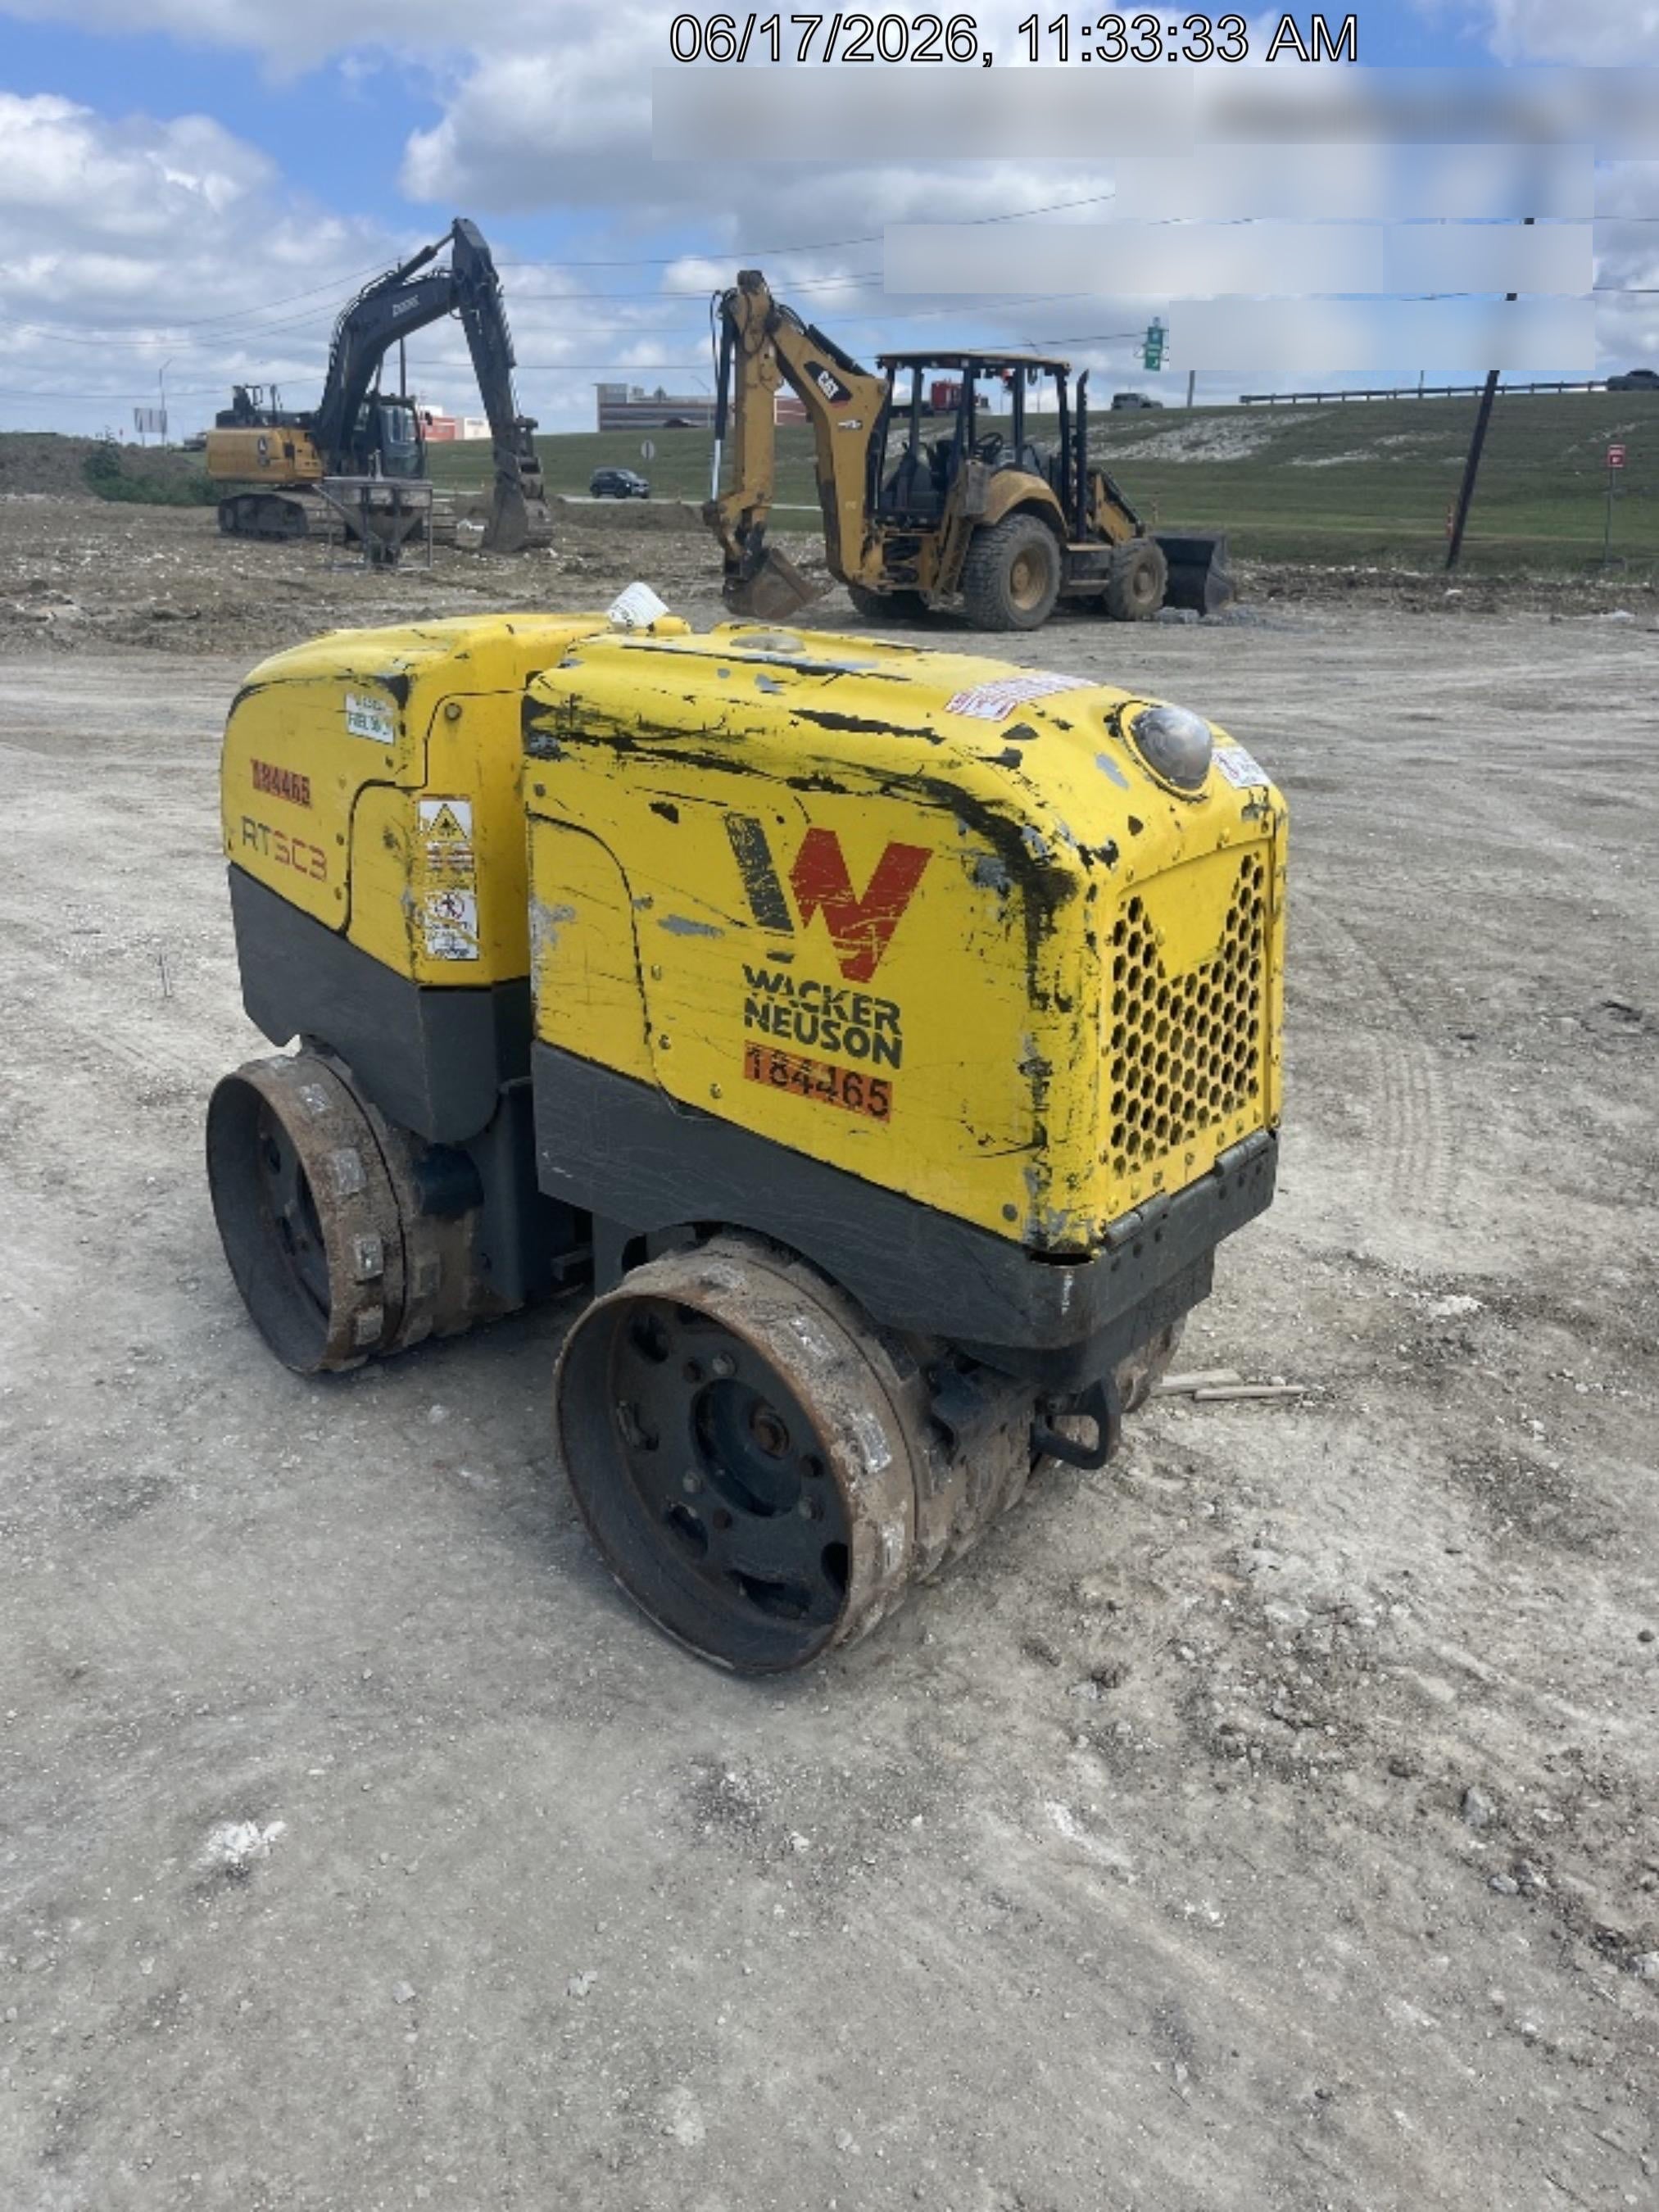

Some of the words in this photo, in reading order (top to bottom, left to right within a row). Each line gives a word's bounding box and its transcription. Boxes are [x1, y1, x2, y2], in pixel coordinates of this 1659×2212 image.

[817, 369, 840, 400] CAT
[741, 963, 903, 1036] WACKER
[744, 997, 903, 1070] NEUSON
[745, 1042, 890, 1117] 184465
